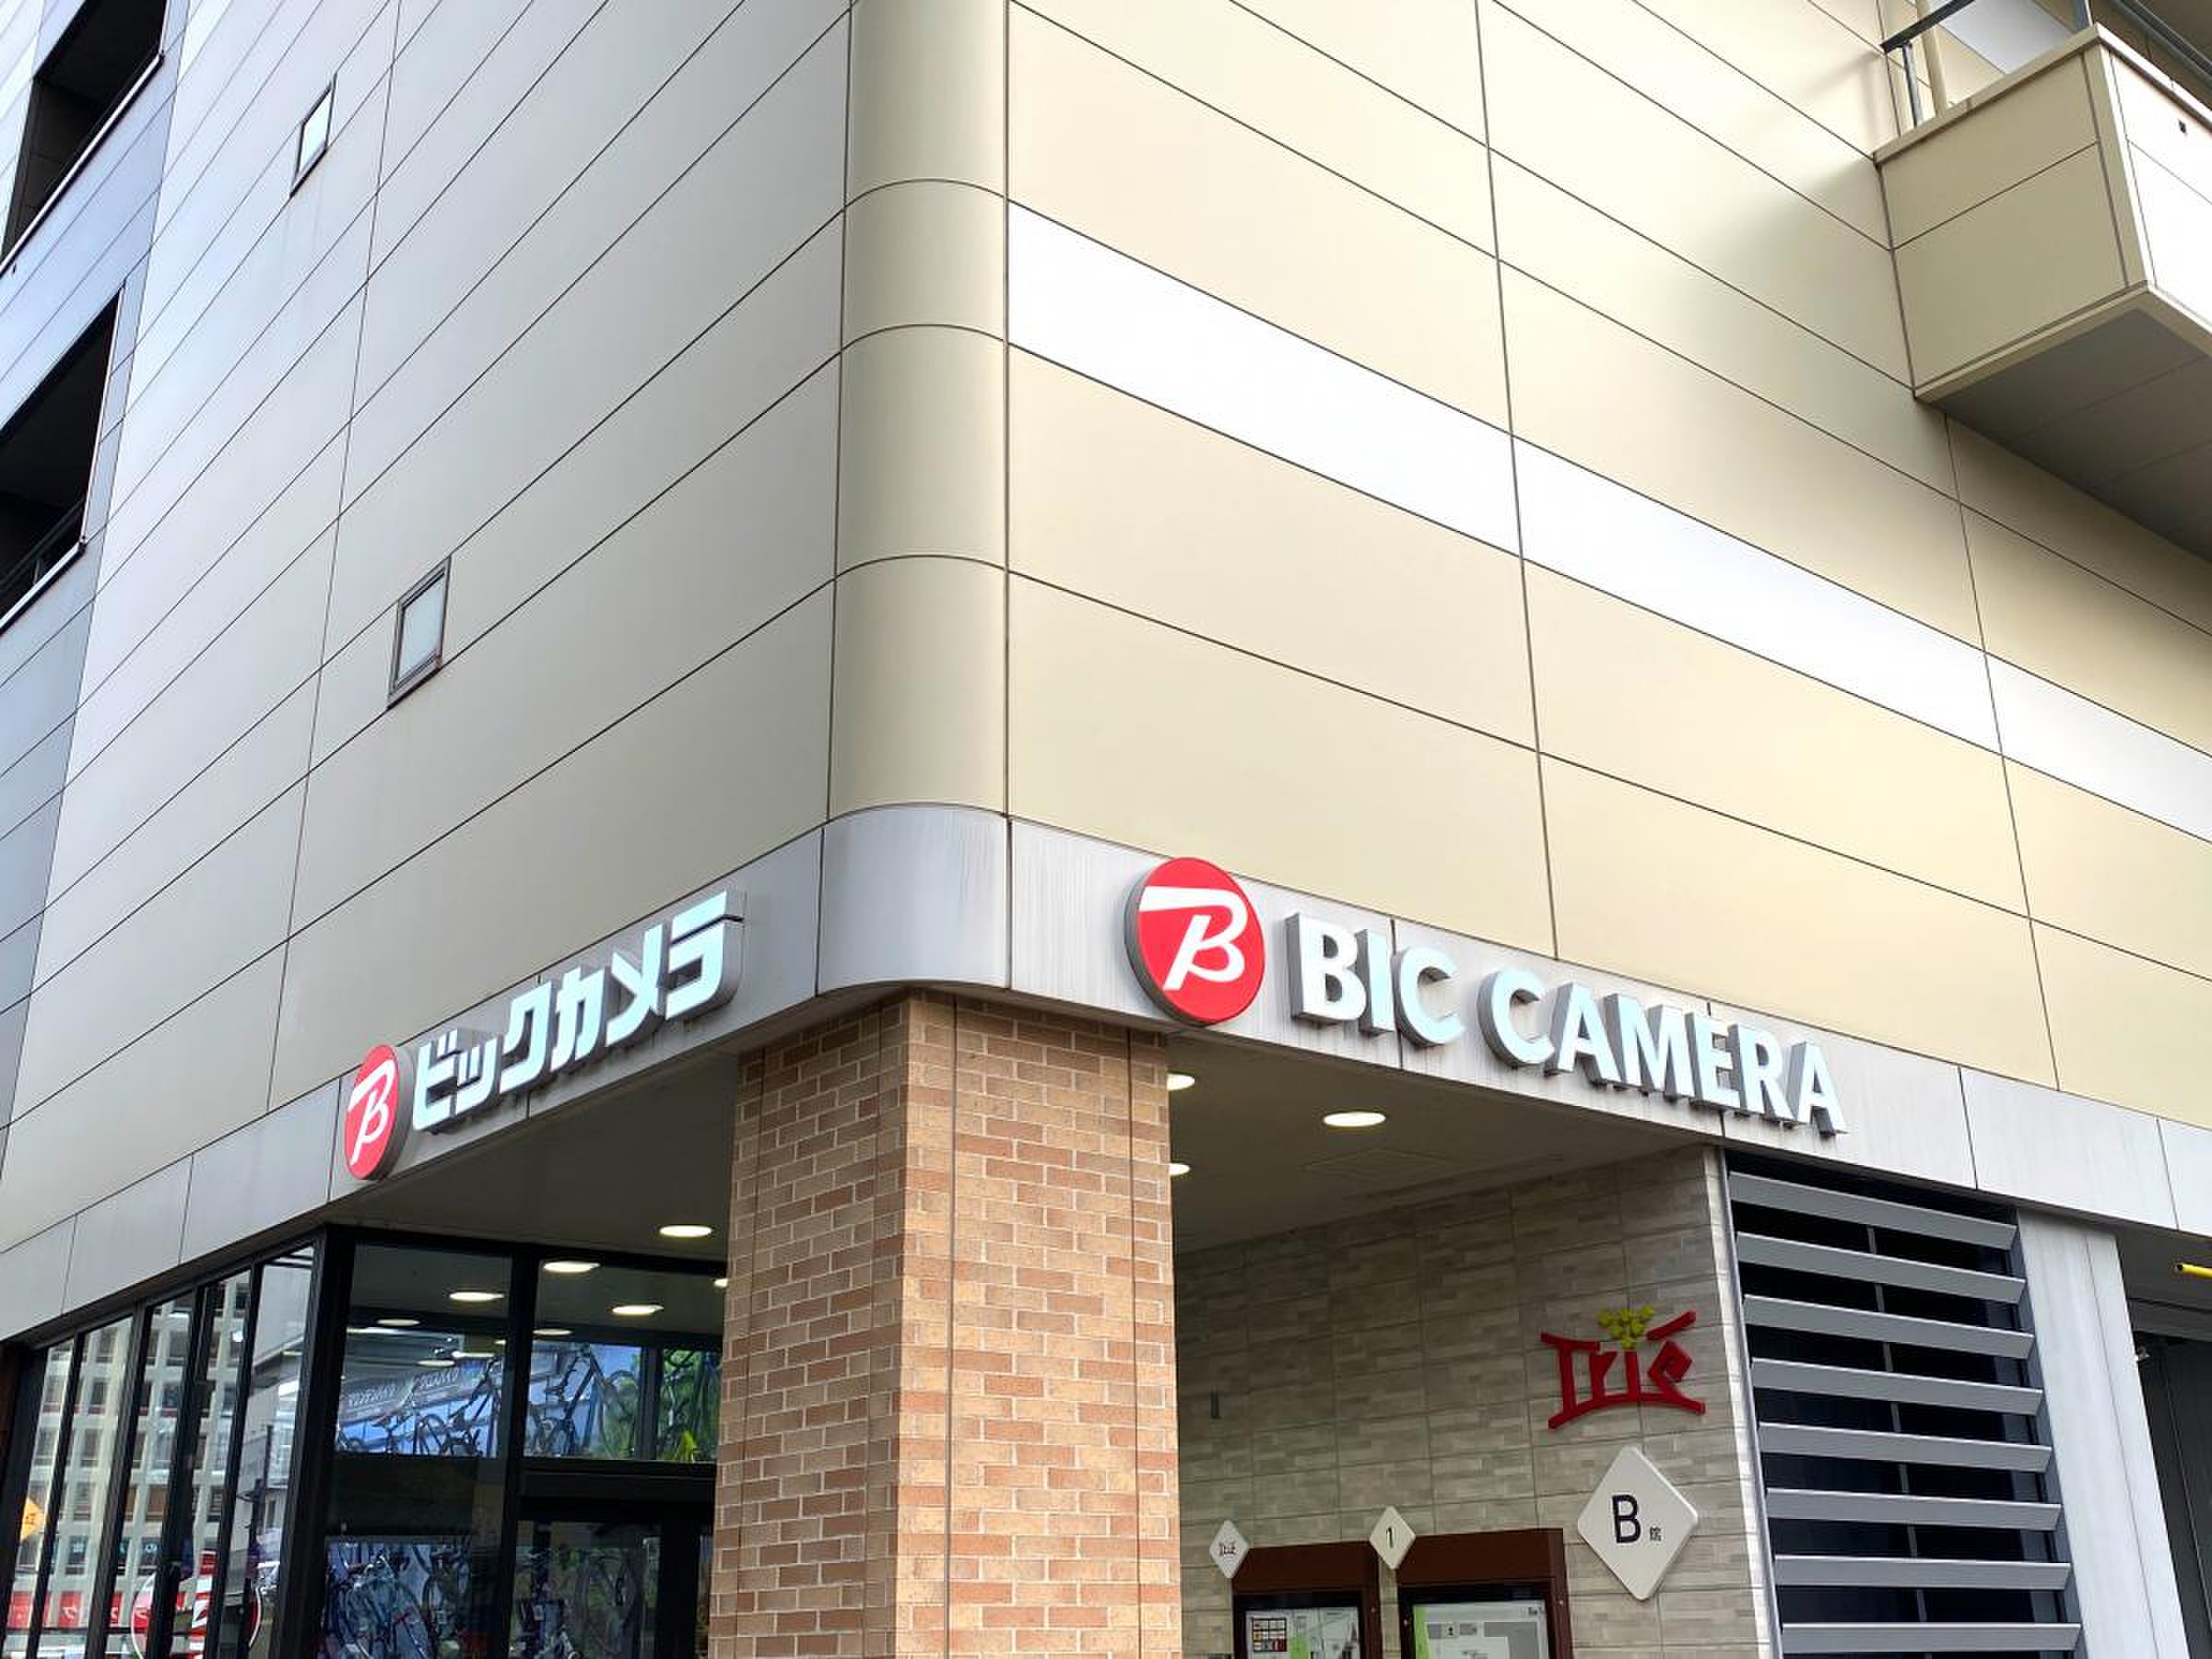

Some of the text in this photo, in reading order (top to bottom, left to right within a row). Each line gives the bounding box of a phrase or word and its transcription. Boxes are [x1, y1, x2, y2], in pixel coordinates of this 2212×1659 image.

[412, 890, 728, 1133] ビックカメラ
[1292, 914, 1846, 1134] BIC CAMERA
